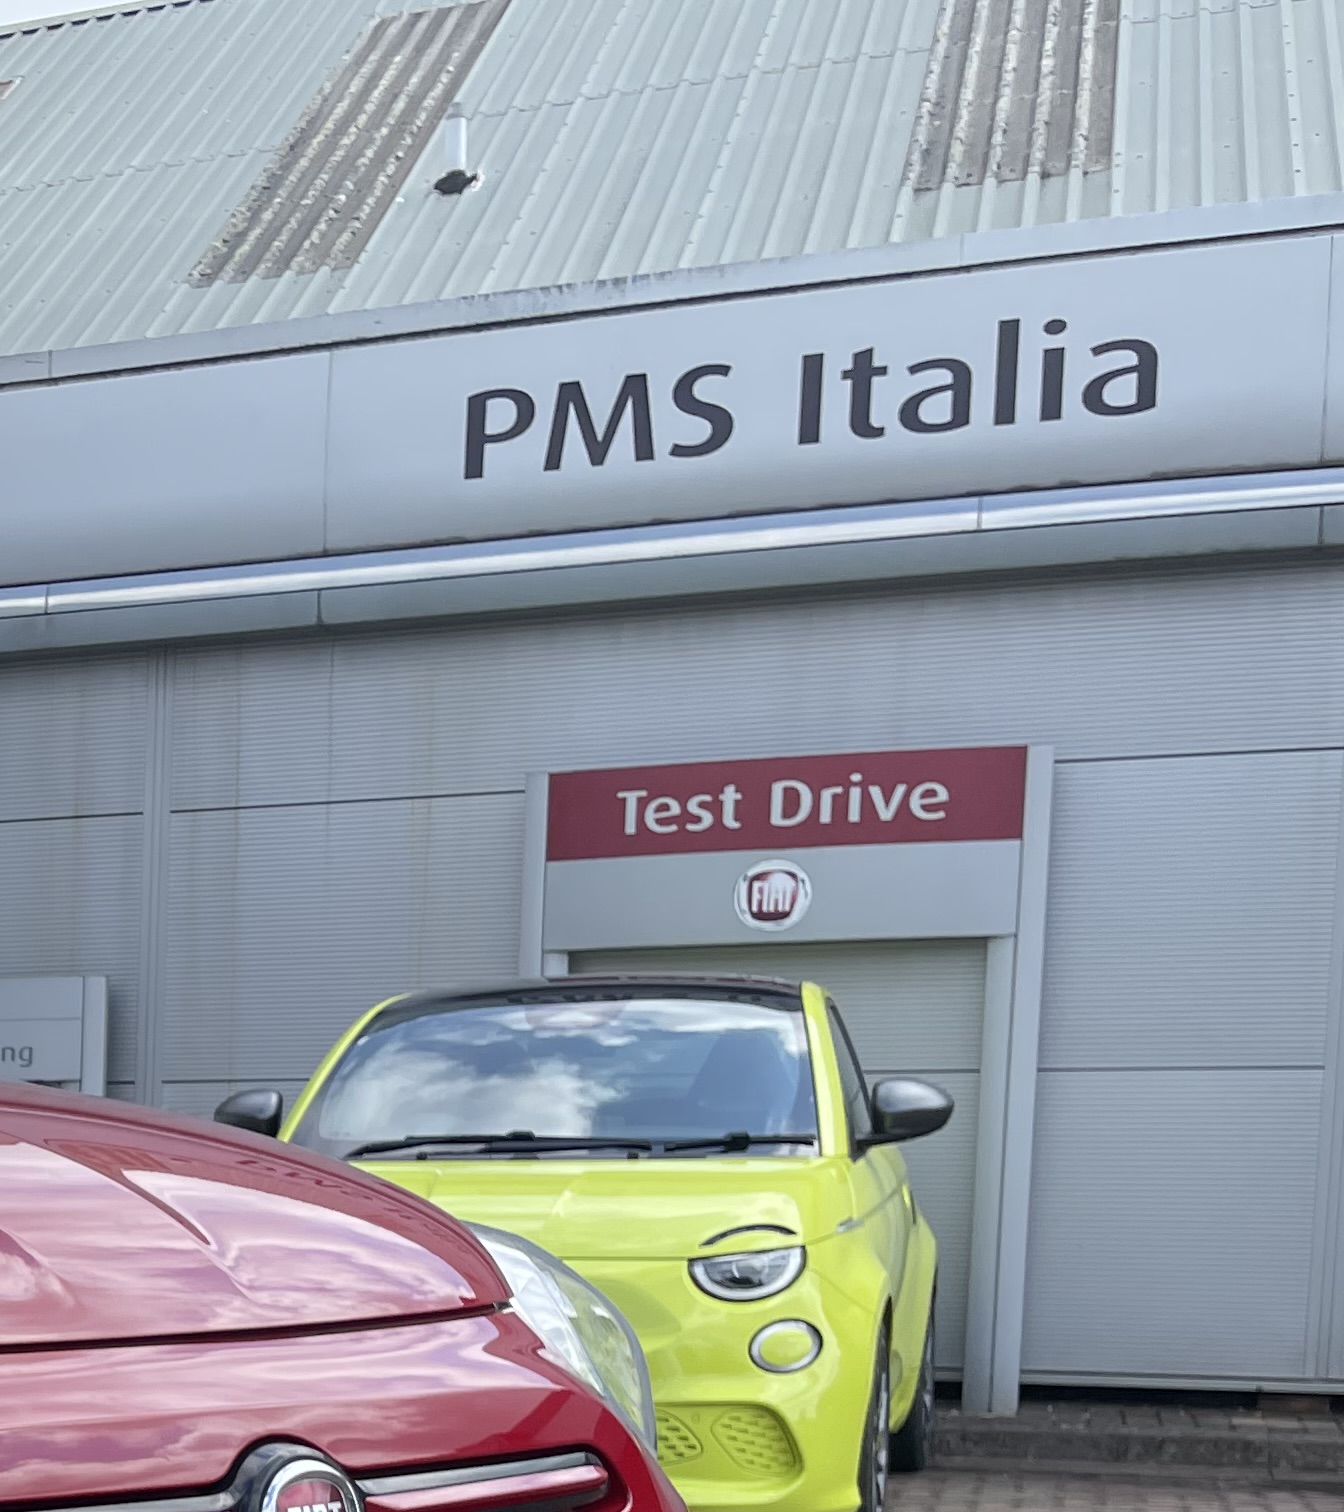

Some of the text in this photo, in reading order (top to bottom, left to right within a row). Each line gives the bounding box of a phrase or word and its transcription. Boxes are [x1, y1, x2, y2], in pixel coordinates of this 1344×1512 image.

[462, 317, 1160, 480] PMS Italia
[616, 771, 950, 836] Test Drive
[751, 874, 797, 914] FIAT
